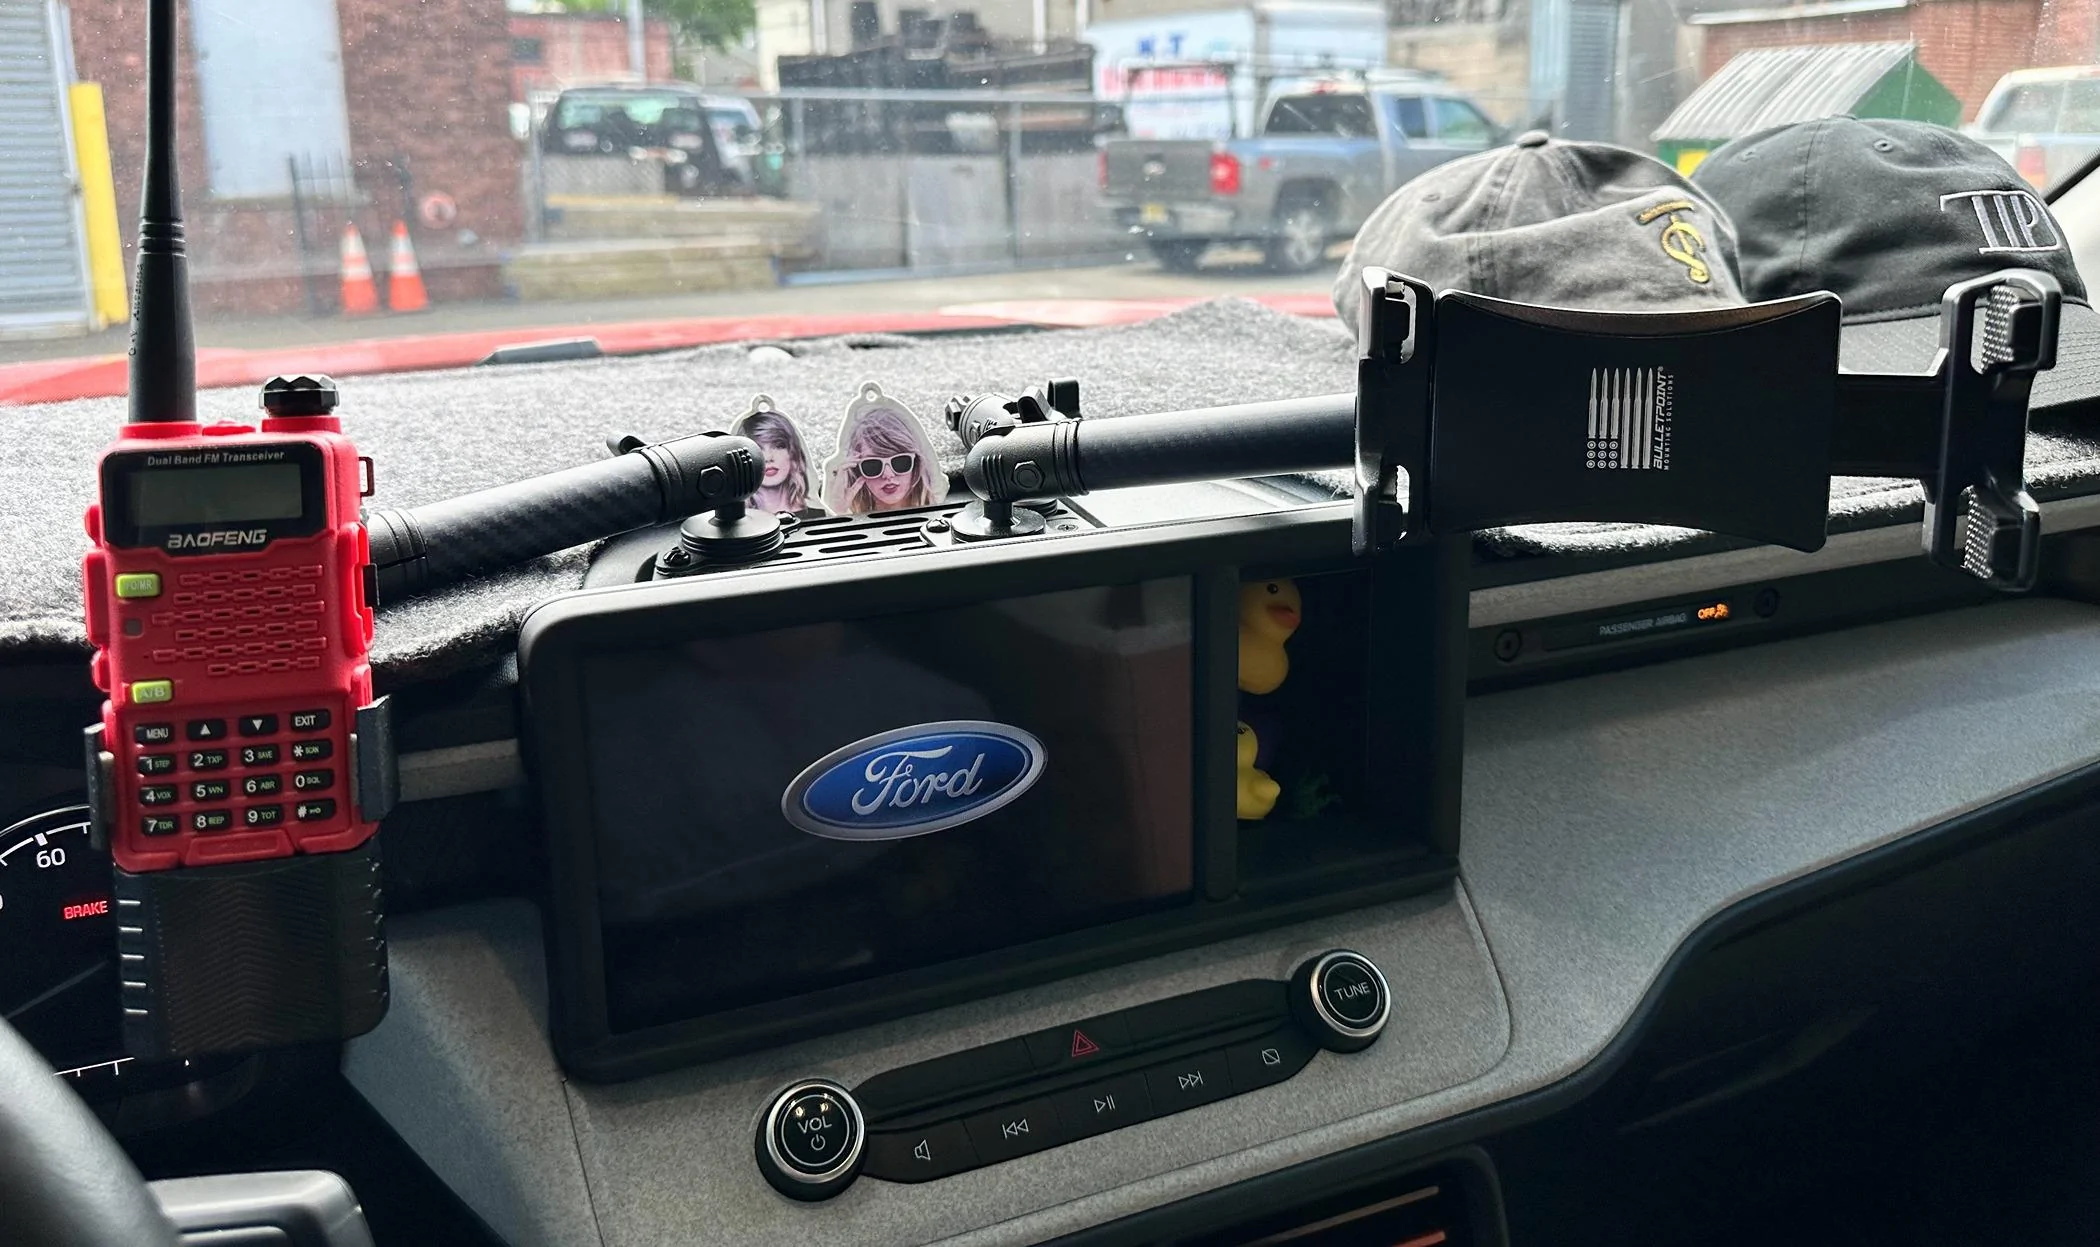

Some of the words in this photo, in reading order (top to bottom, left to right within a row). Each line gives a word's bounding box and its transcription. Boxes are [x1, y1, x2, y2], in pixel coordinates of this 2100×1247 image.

[1665, 374, 1674, 422] SOLUTIONS
[1663, 426, 1672, 471] MOUNTING
[147, 455, 172, 466] Dual
[174, 454, 202, 465] Band
[204, 453, 220, 463] FM
[222, 450, 285, 462] Transceiver
[167, 529, 268, 549] BAOFENG
[1599, 618, 1654, 636] PASSENGER
[1655, 612, 1688, 627] AIRBAG
[1697, 607, 1716, 620] OFF
[294, 715, 316, 727] EXIT
[146, 728, 169, 739] MENU
[194, 753, 204, 767] 2
[207, 755, 223, 764] TXP
[244, 749, 255, 762] 3
[257, 750, 273, 759] SAVE
[146, 759, 153, 770] 1
[154, 760, 170, 768] STEP
[246, 779, 257, 793] 6
[260, 781, 276, 790] ABR
[295, 775, 305, 788] 0
[851, 745, 986, 816] Ford
[146, 790, 156, 802] 4
[156, 791, 172, 799] VOX
[196, 785, 206, 798] 5
[196, 815, 207, 828] 8
[208, 816, 225, 825] BEEP
[248, 810, 259, 823] 9
[261, 811, 277, 820] TOT
[147, 820, 157, 833] 7
[158, 820, 174, 829] TDR
[36, 847, 66, 869] 60
[63, 900, 109, 920] BRAKE
[1333, 981, 1370, 1000] TUNE
[796, 1115, 833, 1134] VOL
